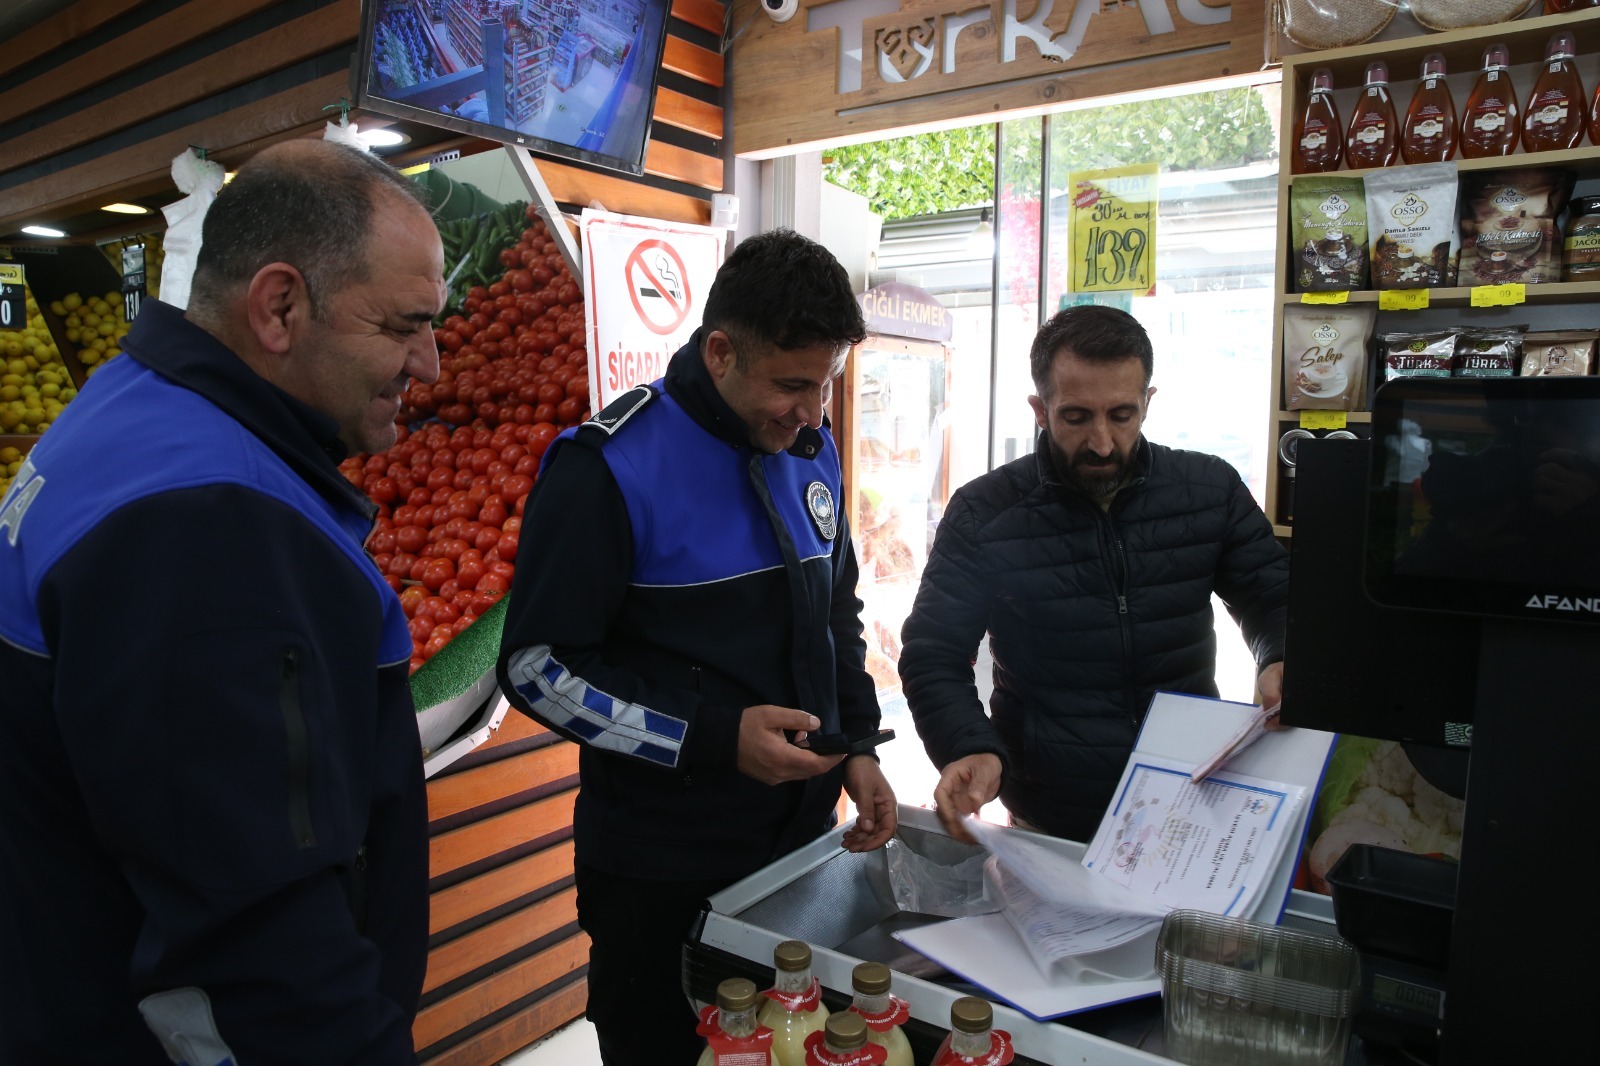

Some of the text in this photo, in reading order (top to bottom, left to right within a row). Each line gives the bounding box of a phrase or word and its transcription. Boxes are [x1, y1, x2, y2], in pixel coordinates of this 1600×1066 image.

[1321, 204, 1348, 212] OSSO
[1394, 206, 1424, 215] OSSO
[1083, 227, 1147, 288] 139
[863, 290, 946, 328] ÇİĞLİ EKMEK
[608, 341, 661, 391] SİGARA
[1300, 346, 1344, 368] Salep
[1465, 355, 1497, 369] TÜRK
